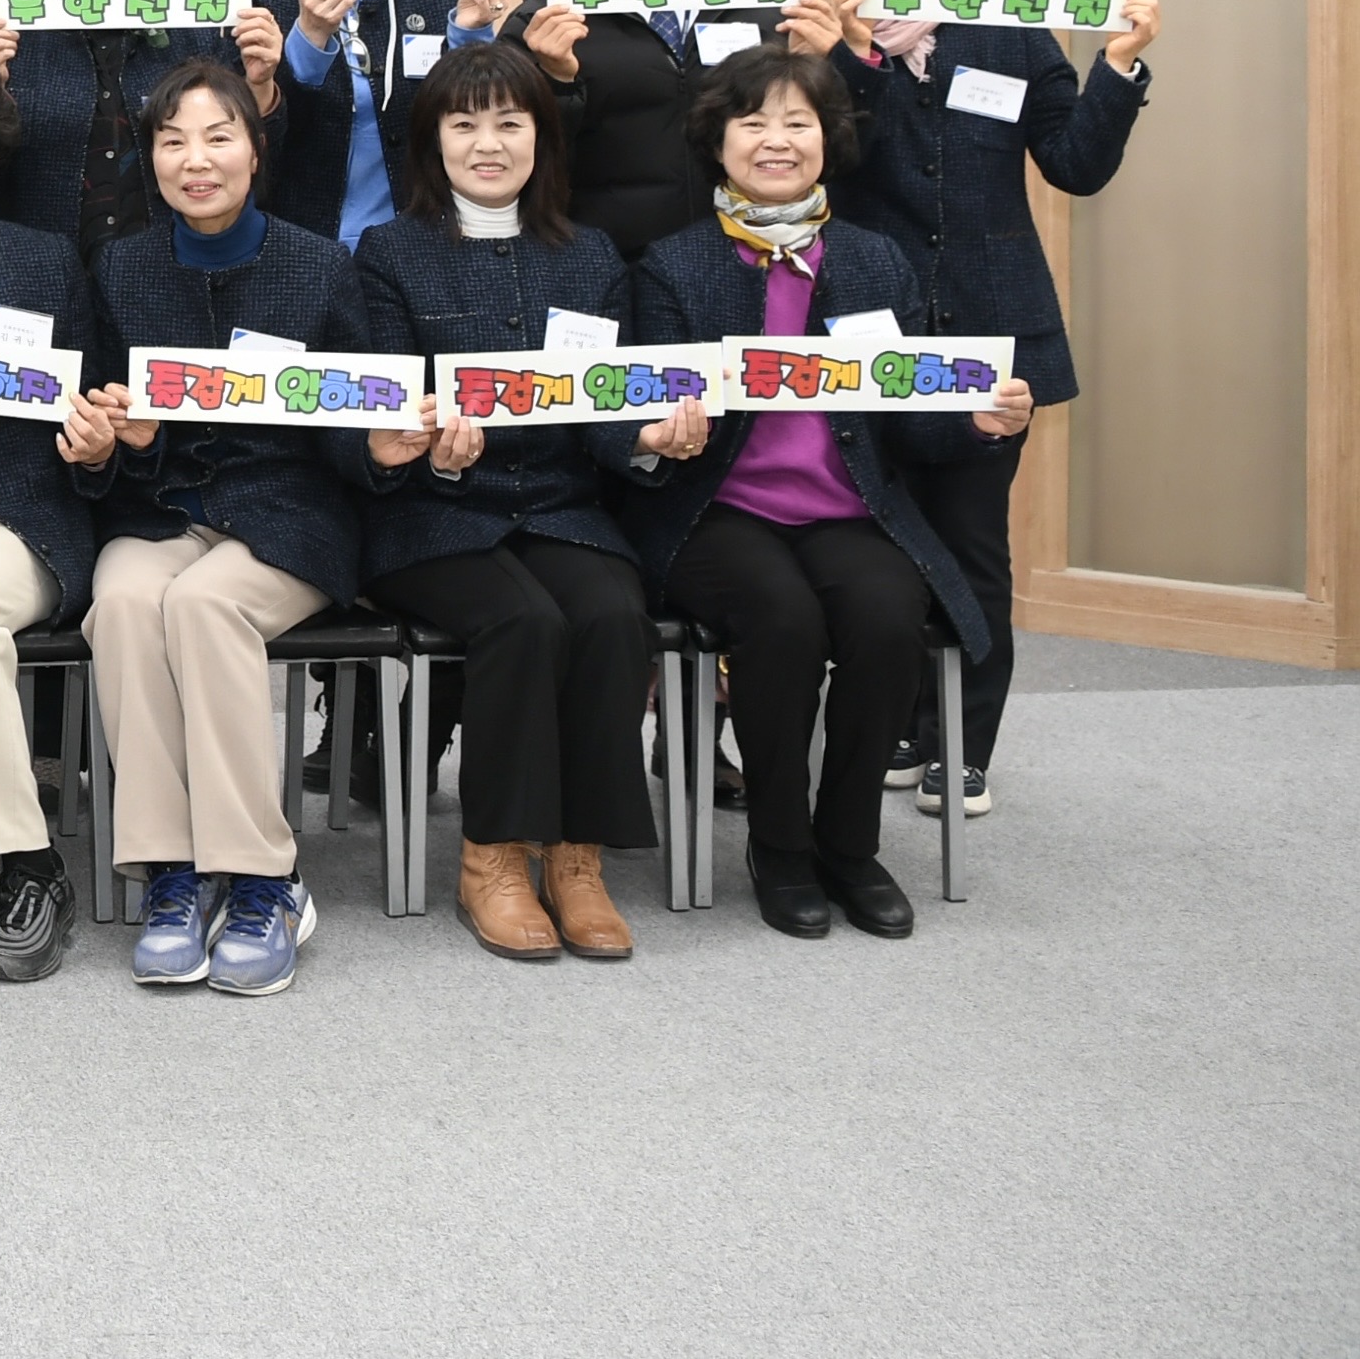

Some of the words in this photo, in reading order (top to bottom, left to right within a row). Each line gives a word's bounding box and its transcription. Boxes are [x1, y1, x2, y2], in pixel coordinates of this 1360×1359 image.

[146, 359, 264, 409] 즐겁게
[276, 365, 407, 413] 일하자
[455, 366, 574, 417] 즐겁게
[584, 363, 706, 410] 일하자
[741, 348, 861, 398] 즐겁게
[871, 351, 997, 398] 일하자
